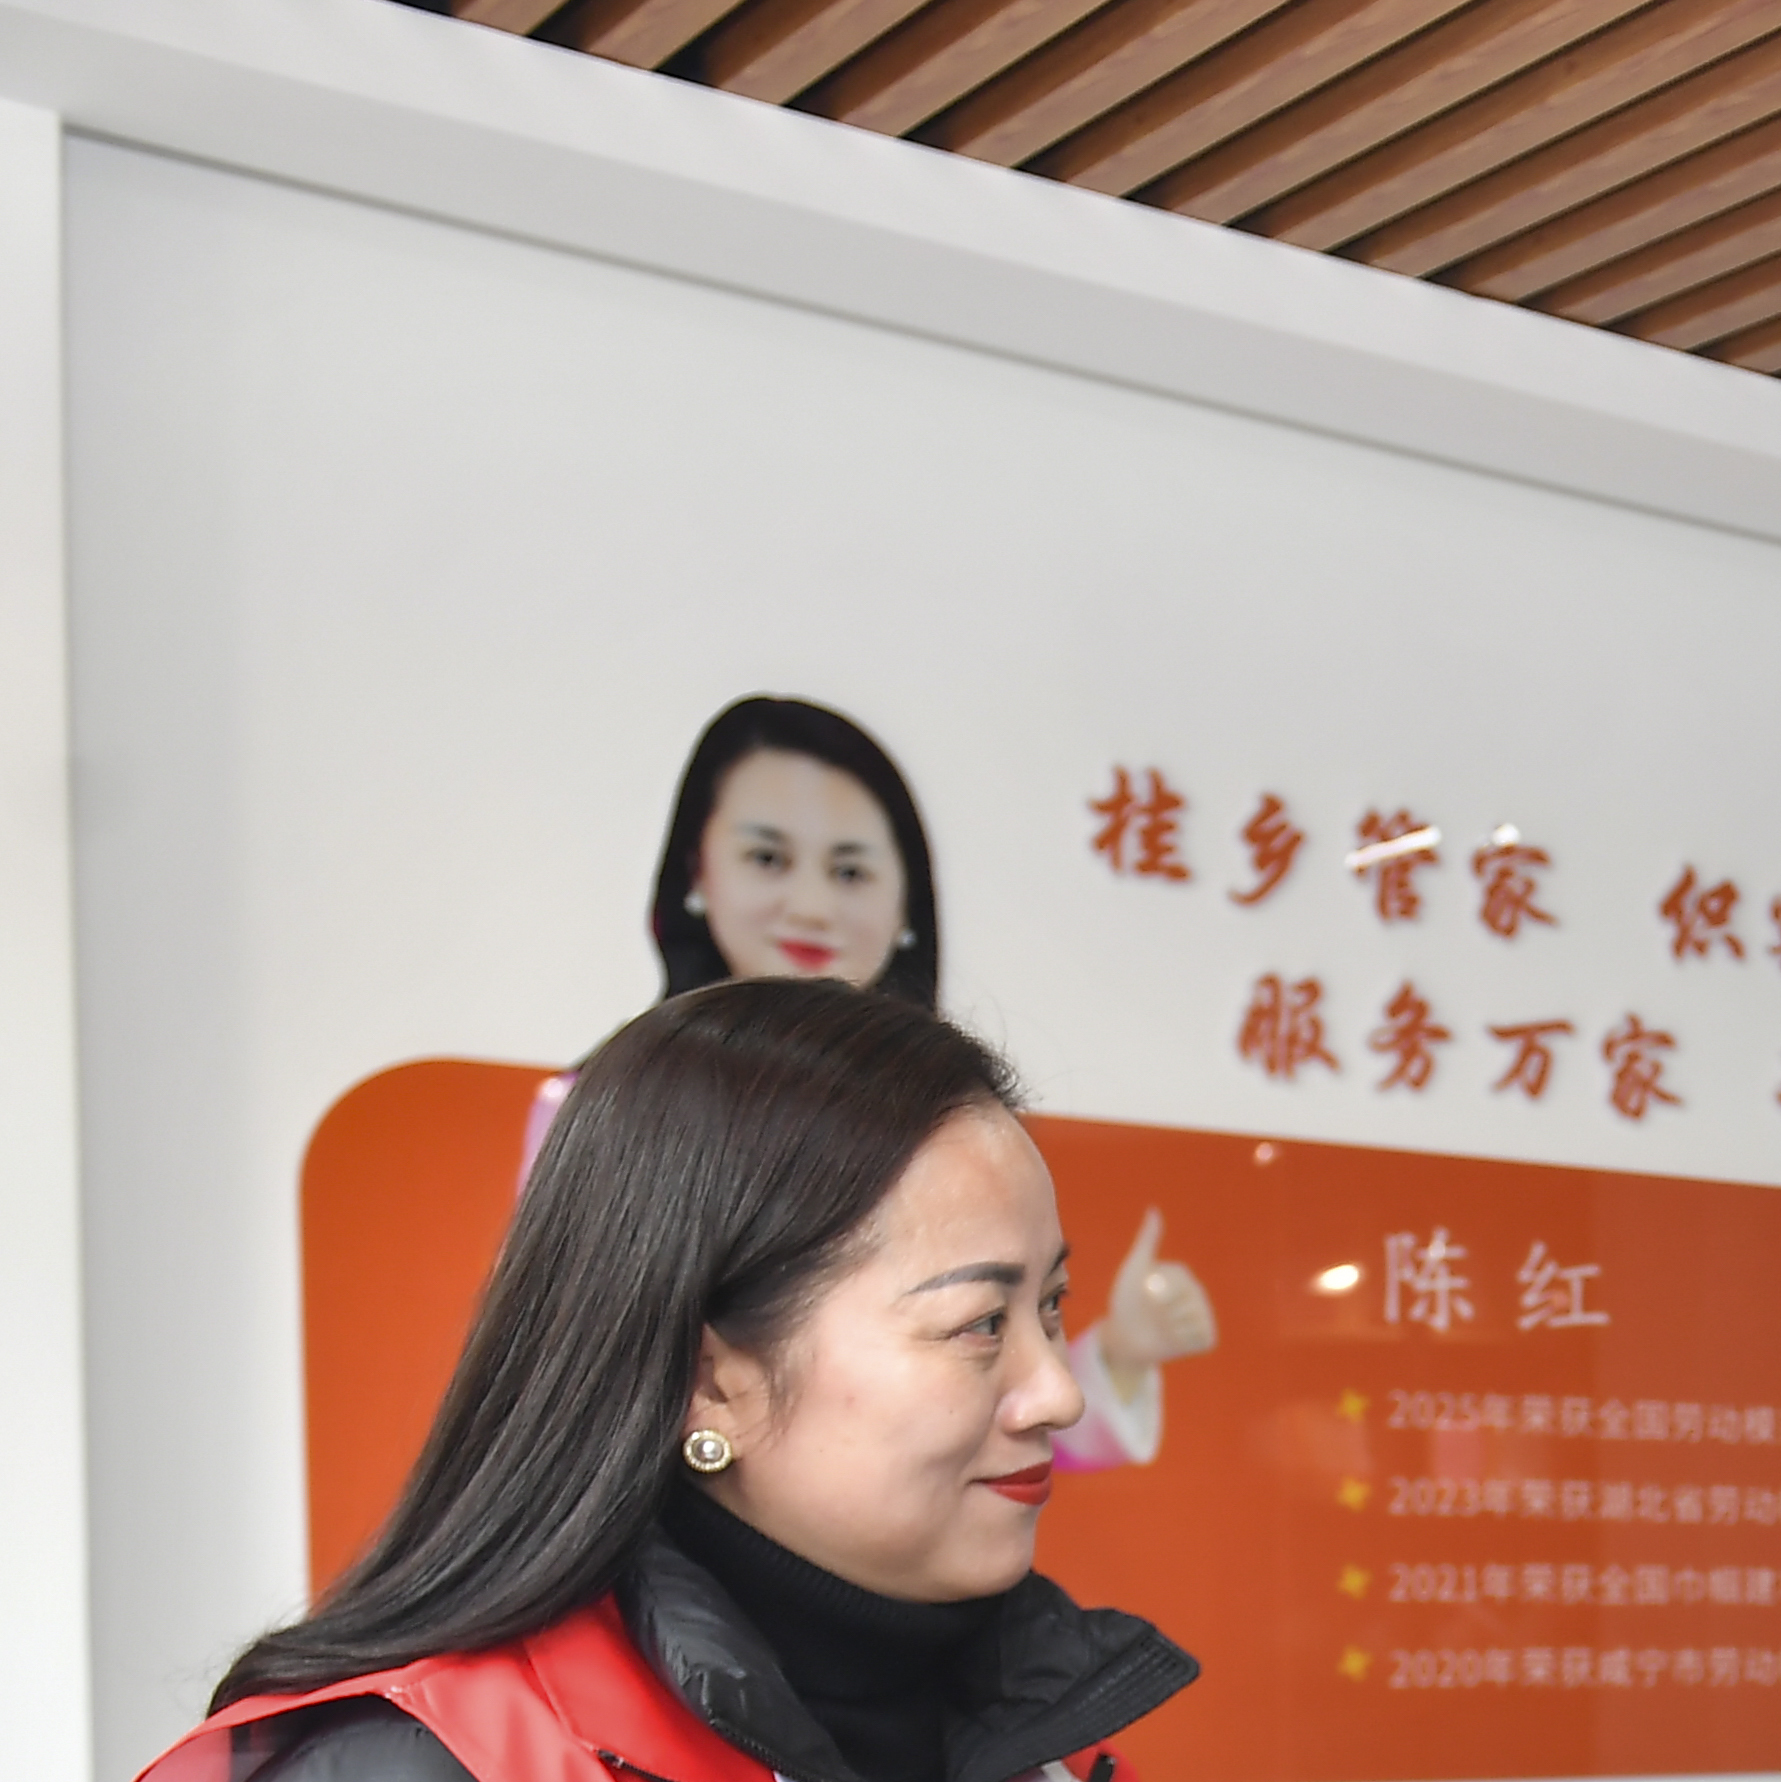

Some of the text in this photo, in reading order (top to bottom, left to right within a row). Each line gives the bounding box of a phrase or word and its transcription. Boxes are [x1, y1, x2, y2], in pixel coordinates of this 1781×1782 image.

[1087, 765, 1560, 939] 桂乡管家
[1236, 971, 1684, 1122] 服务万家
